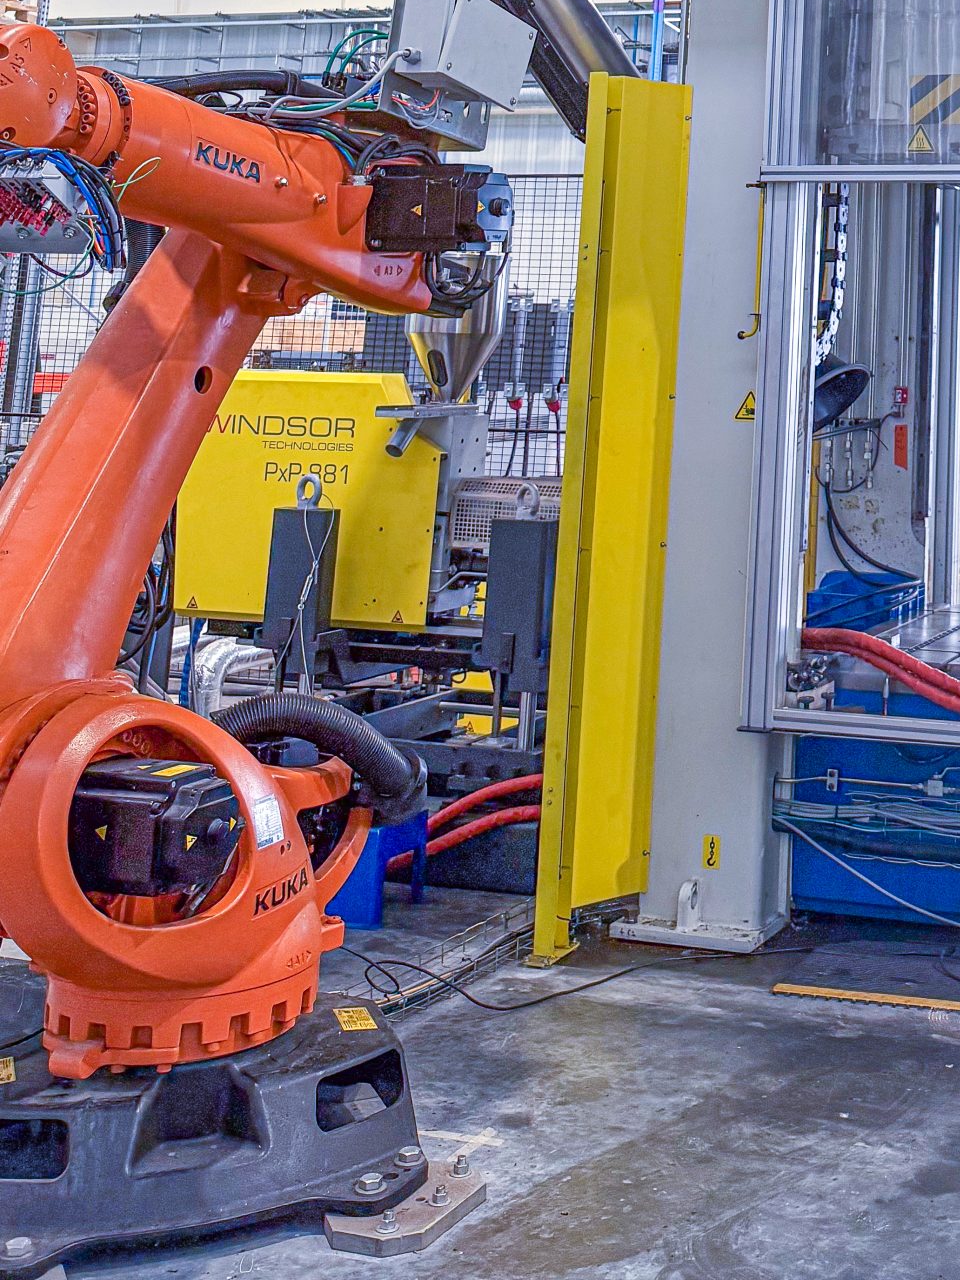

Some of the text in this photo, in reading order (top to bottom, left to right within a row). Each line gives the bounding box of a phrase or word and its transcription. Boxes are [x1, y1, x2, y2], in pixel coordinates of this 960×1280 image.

[195, 141, 261, 184] KUKA
[207, 414, 356, 438] WINDSOR
[262, 440, 354, 452] TECHNOLOGIES
[253, 867, 309, 916] KUKA
